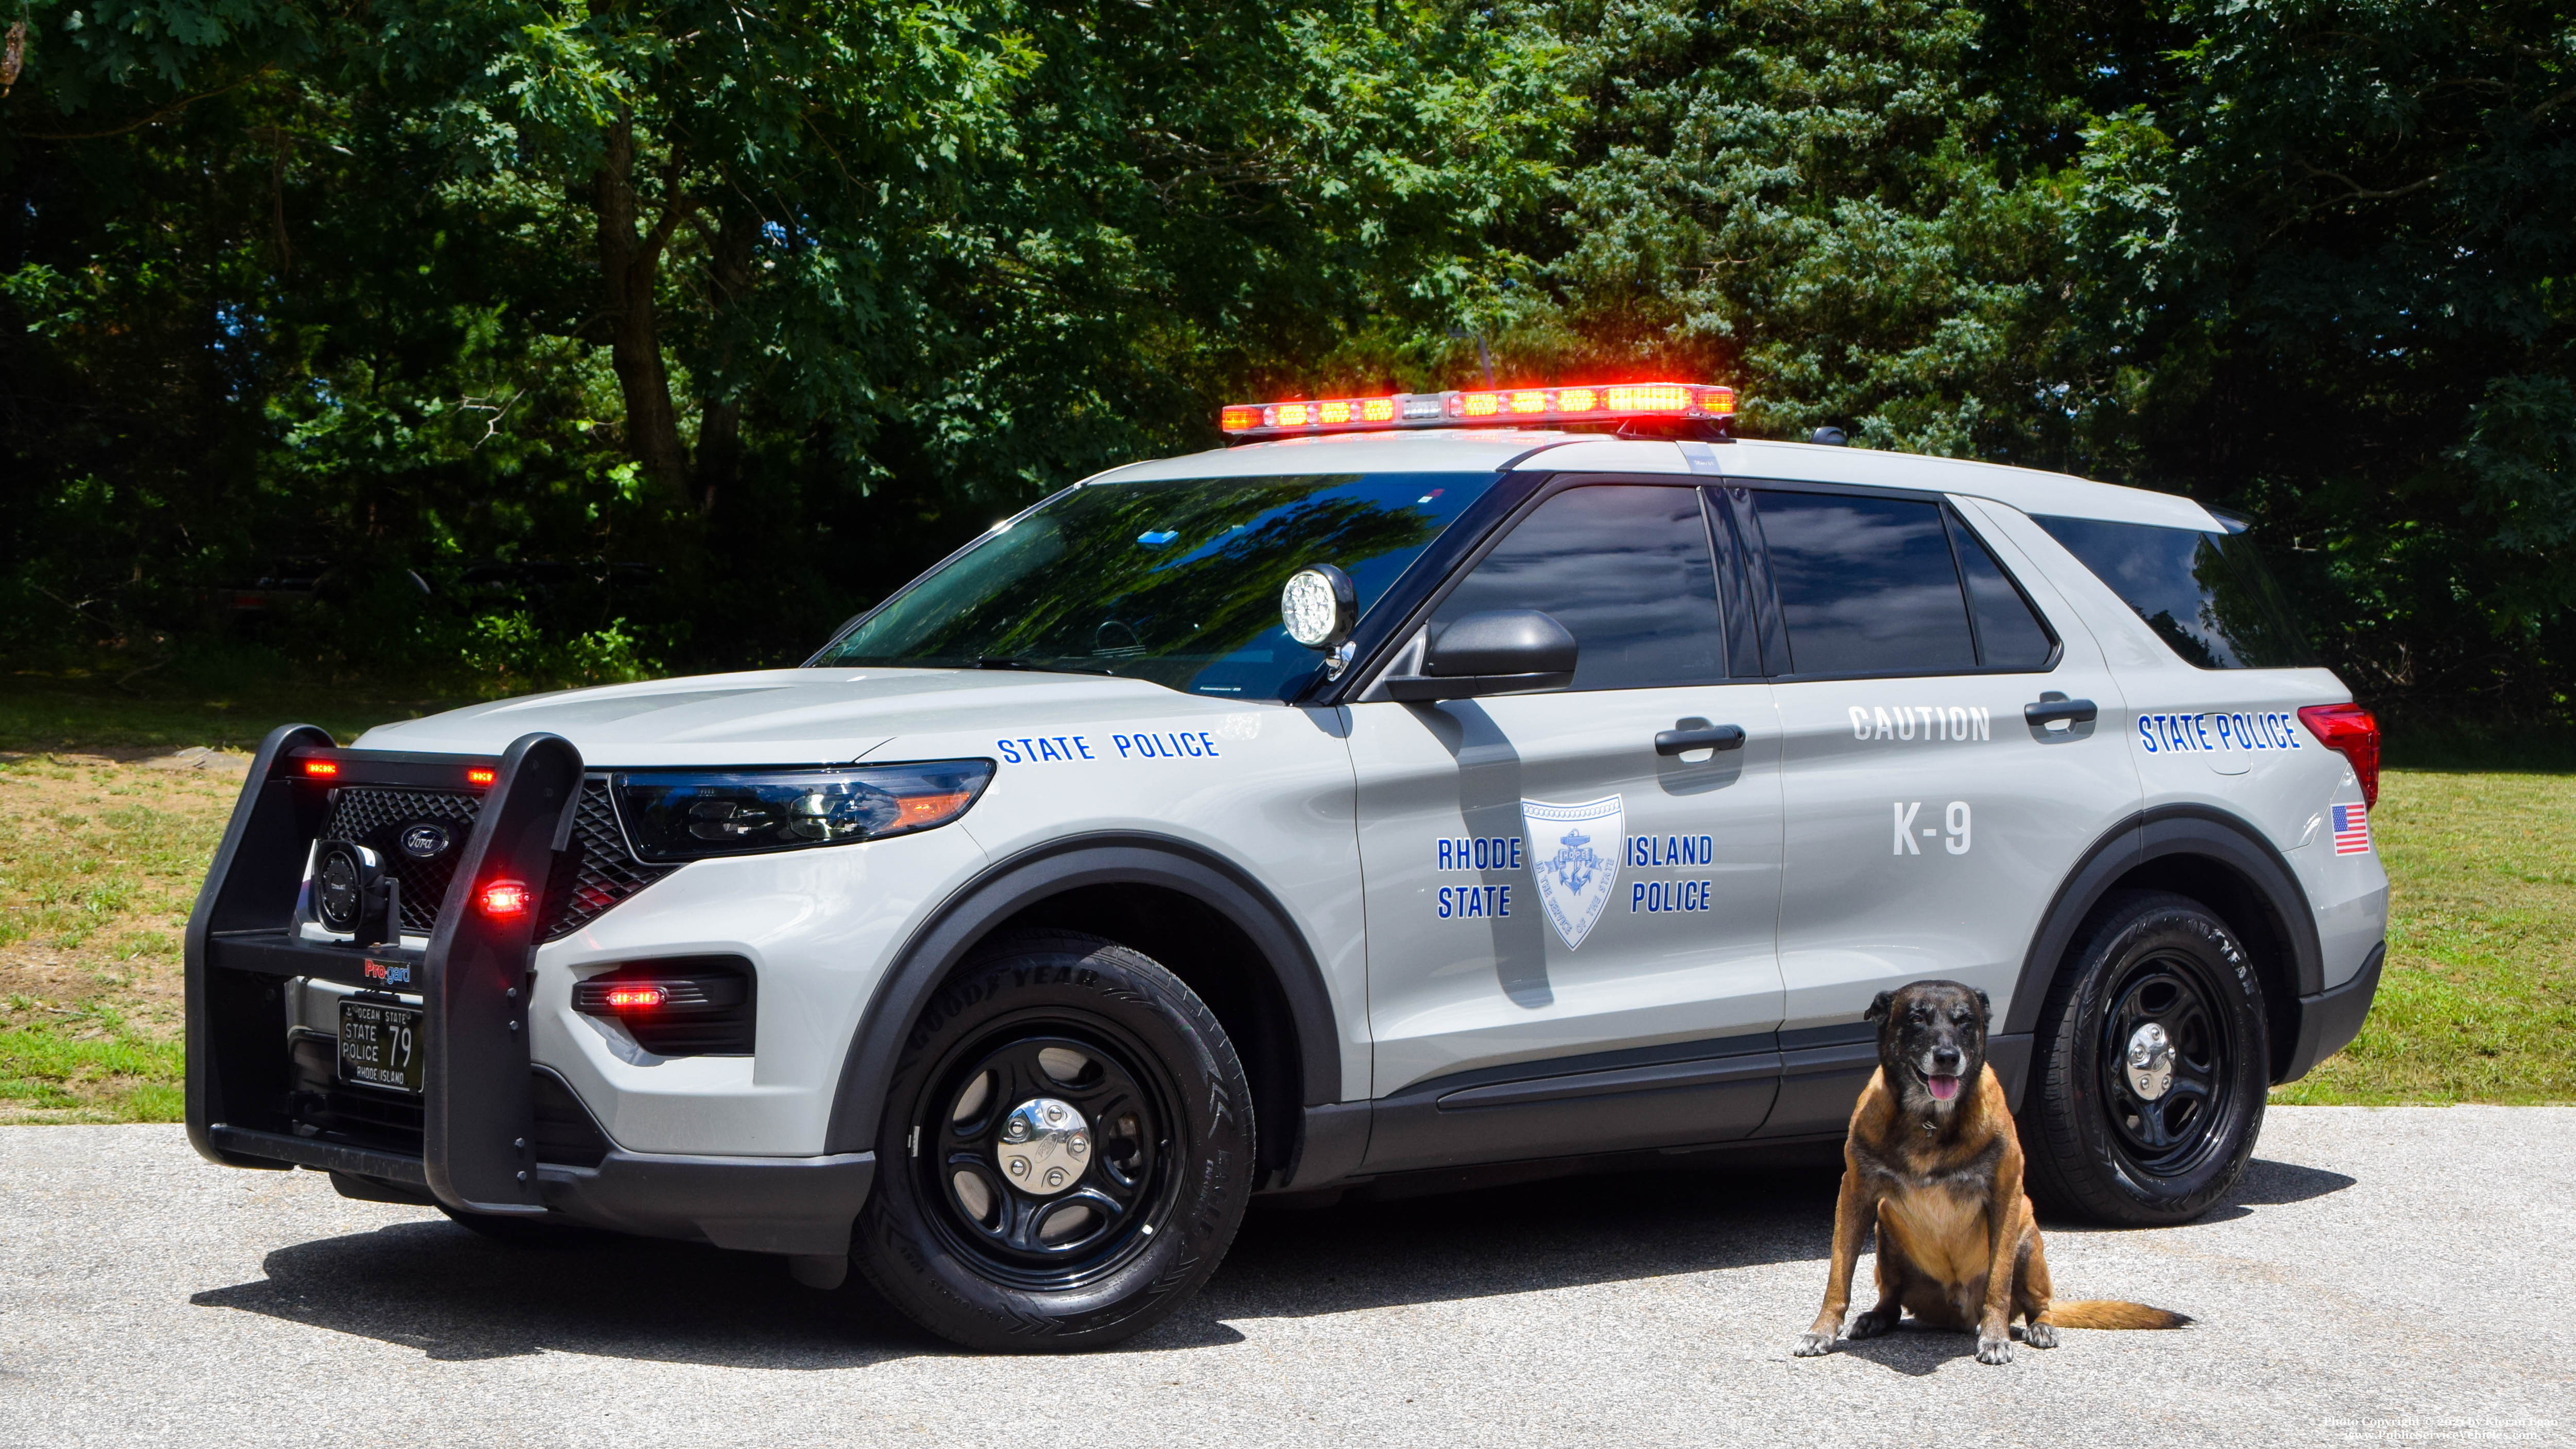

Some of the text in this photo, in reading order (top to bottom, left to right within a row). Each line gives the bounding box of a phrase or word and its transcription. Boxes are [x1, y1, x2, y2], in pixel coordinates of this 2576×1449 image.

[1848, 706, 1990, 741] CAUTION
[2137, 711, 2303, 755] STATE POLICE
[996, 731, 1222, 764] STATE POLICE
[407, 829, 436, 849] Ford
[1893, 801, 1971, 855] K-9
[1437, 834, 1713, 871] RHODE ISLAND
[1564, 850, 1587, 860] HOPE
[1437, 880, 1711, 920] STATE POLICE
[1536, 858, 1614, 935] IN THE SERVICE OF THE STATE
[365, 959, 410, 985] Pro-gard
[346, 1023, 376, 1042] STATE
[358, 1007, 406, 1025] OCEAN STATE
[343, 1042, 379, 1062] POLICE
[389, 1025, 411, 1067] 79
[357, 1066, 404, 1084] RHODE ISLAND
